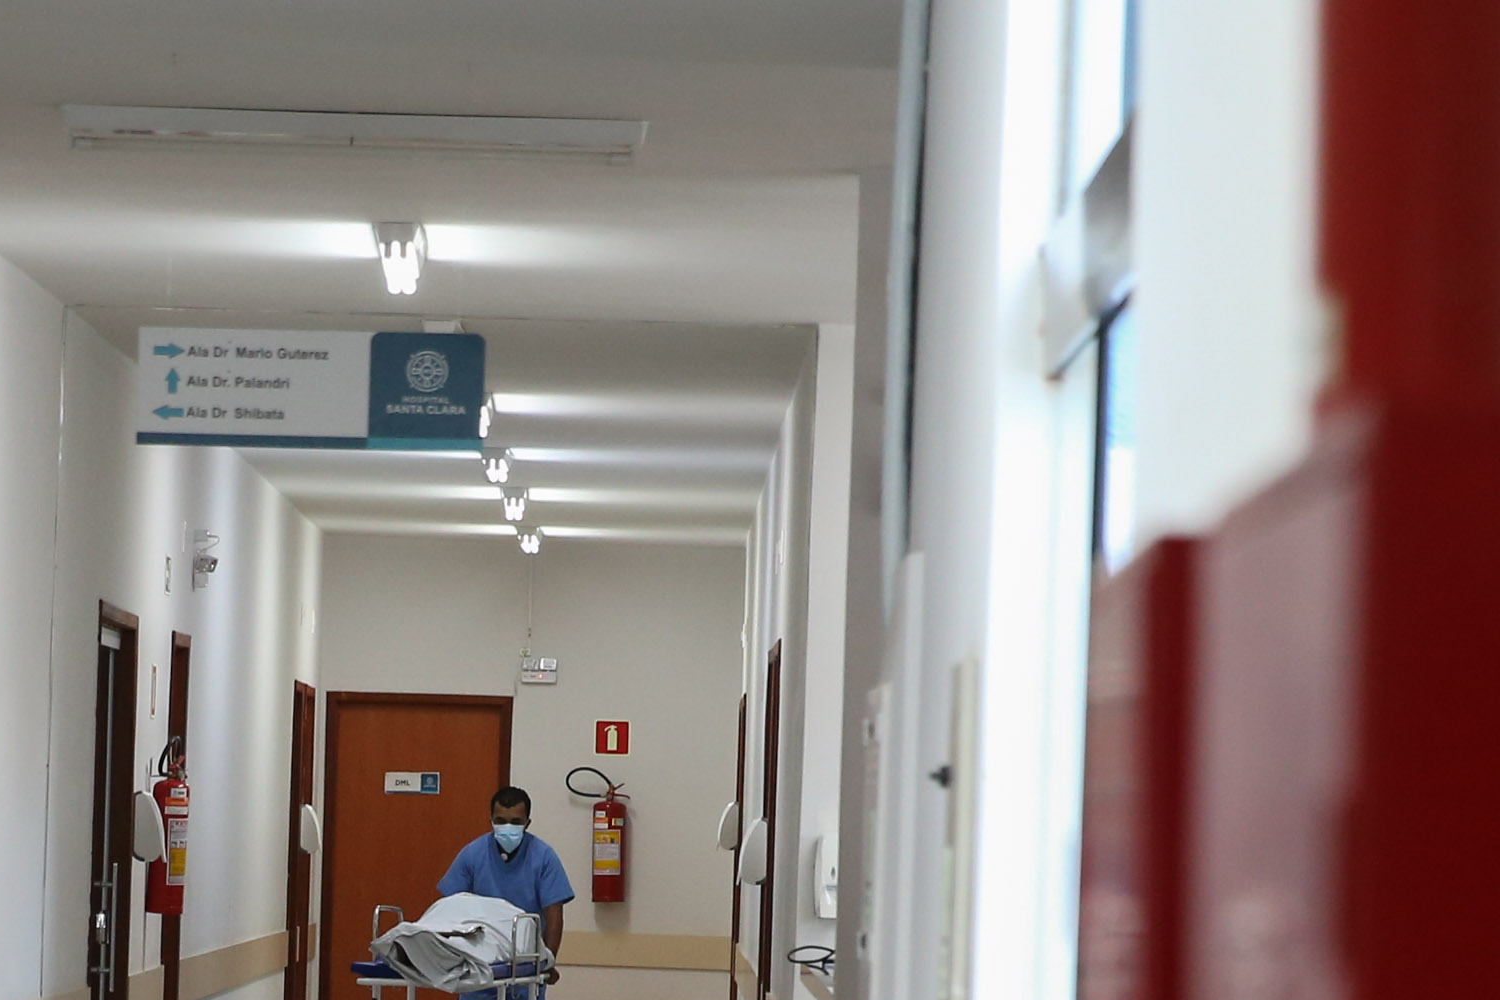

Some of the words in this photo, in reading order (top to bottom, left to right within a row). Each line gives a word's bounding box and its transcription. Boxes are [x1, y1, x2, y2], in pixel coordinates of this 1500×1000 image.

[187, 346, 209, 358] Ala
[236, 347, 273, 359] Mario
[186, 376, 208, 387] Ala
[212, 376, 231, 388] Dr.
[235, 376, 290, 389] Palandri
[186, 406, 208, 418] Ala
[234, 407, 285, 420] Shibata
[386, 404, 425, 414] SANTA
[426, 405, 467, 415] CLARA
